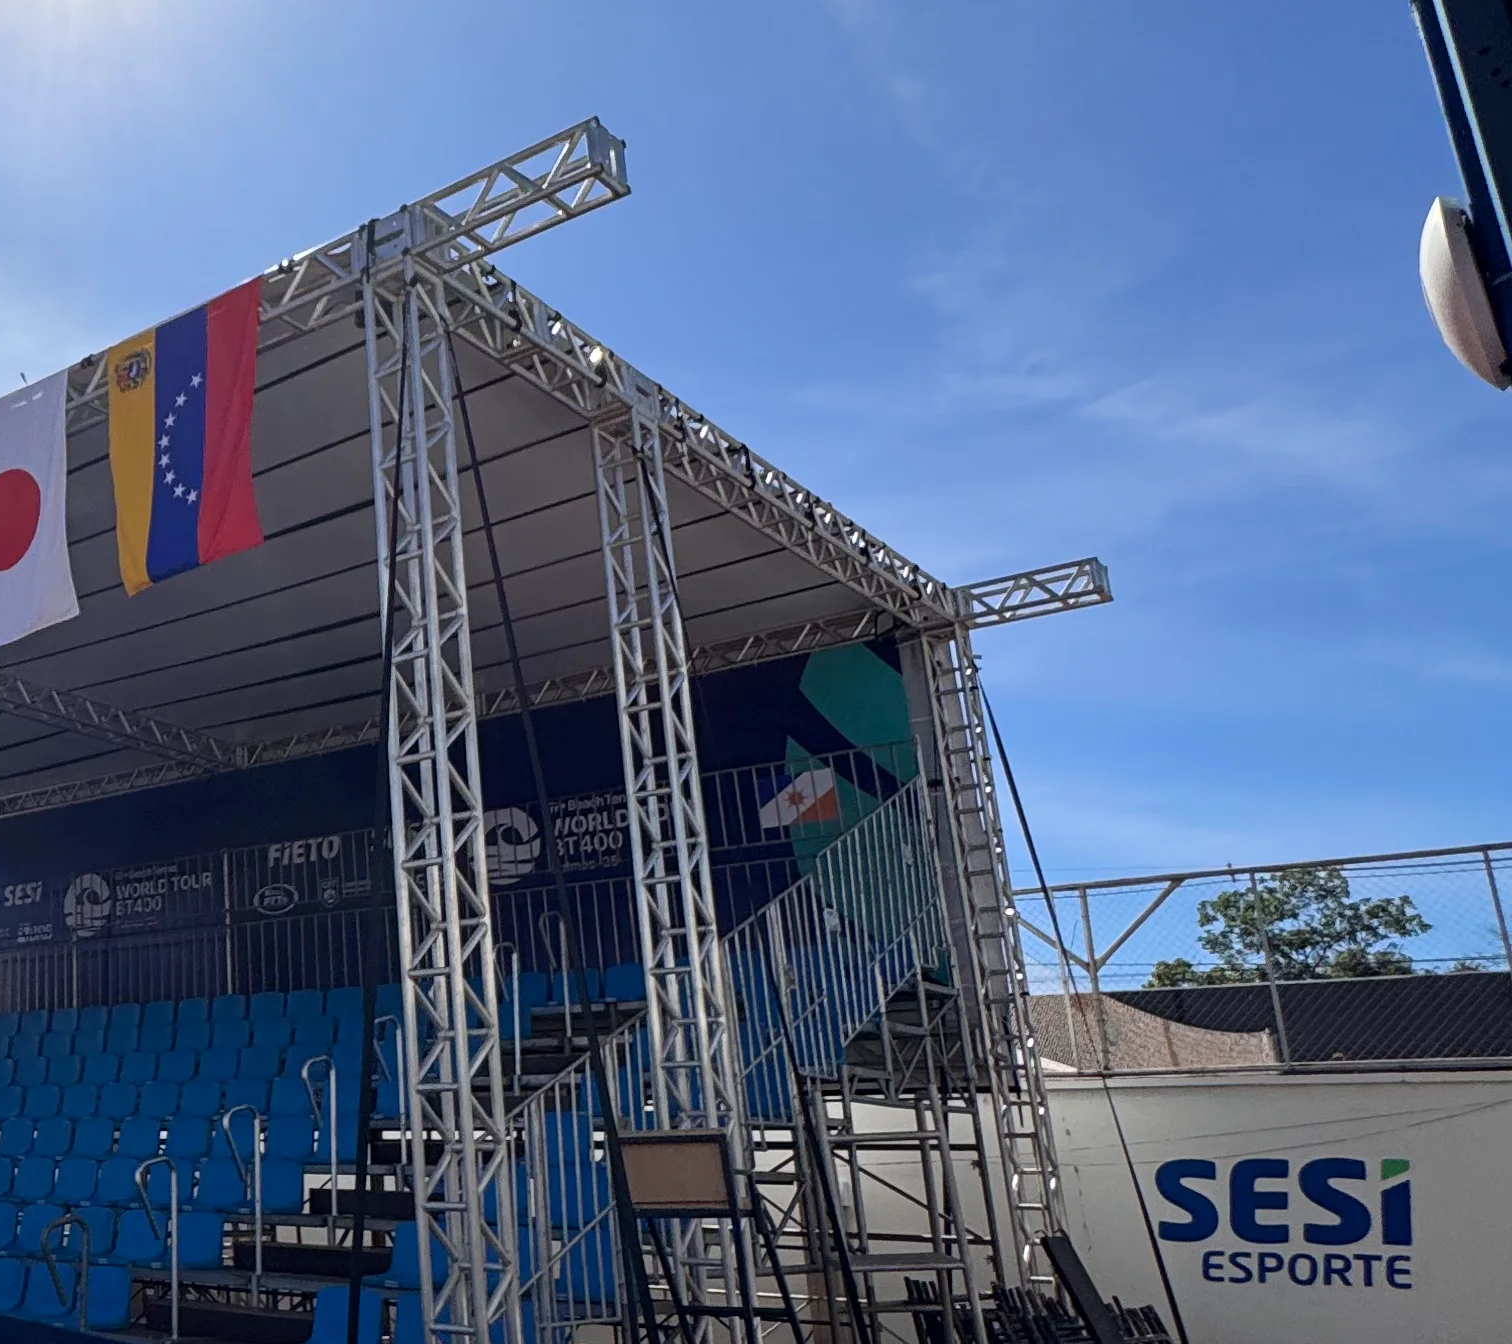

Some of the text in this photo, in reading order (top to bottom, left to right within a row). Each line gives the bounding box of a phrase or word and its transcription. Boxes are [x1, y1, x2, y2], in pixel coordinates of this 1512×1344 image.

[116, 878, 168, 900] WORLD
[171, 871, 213, 893] TOUR
[1201, 1250, 1413, 1290] ESPORTE
